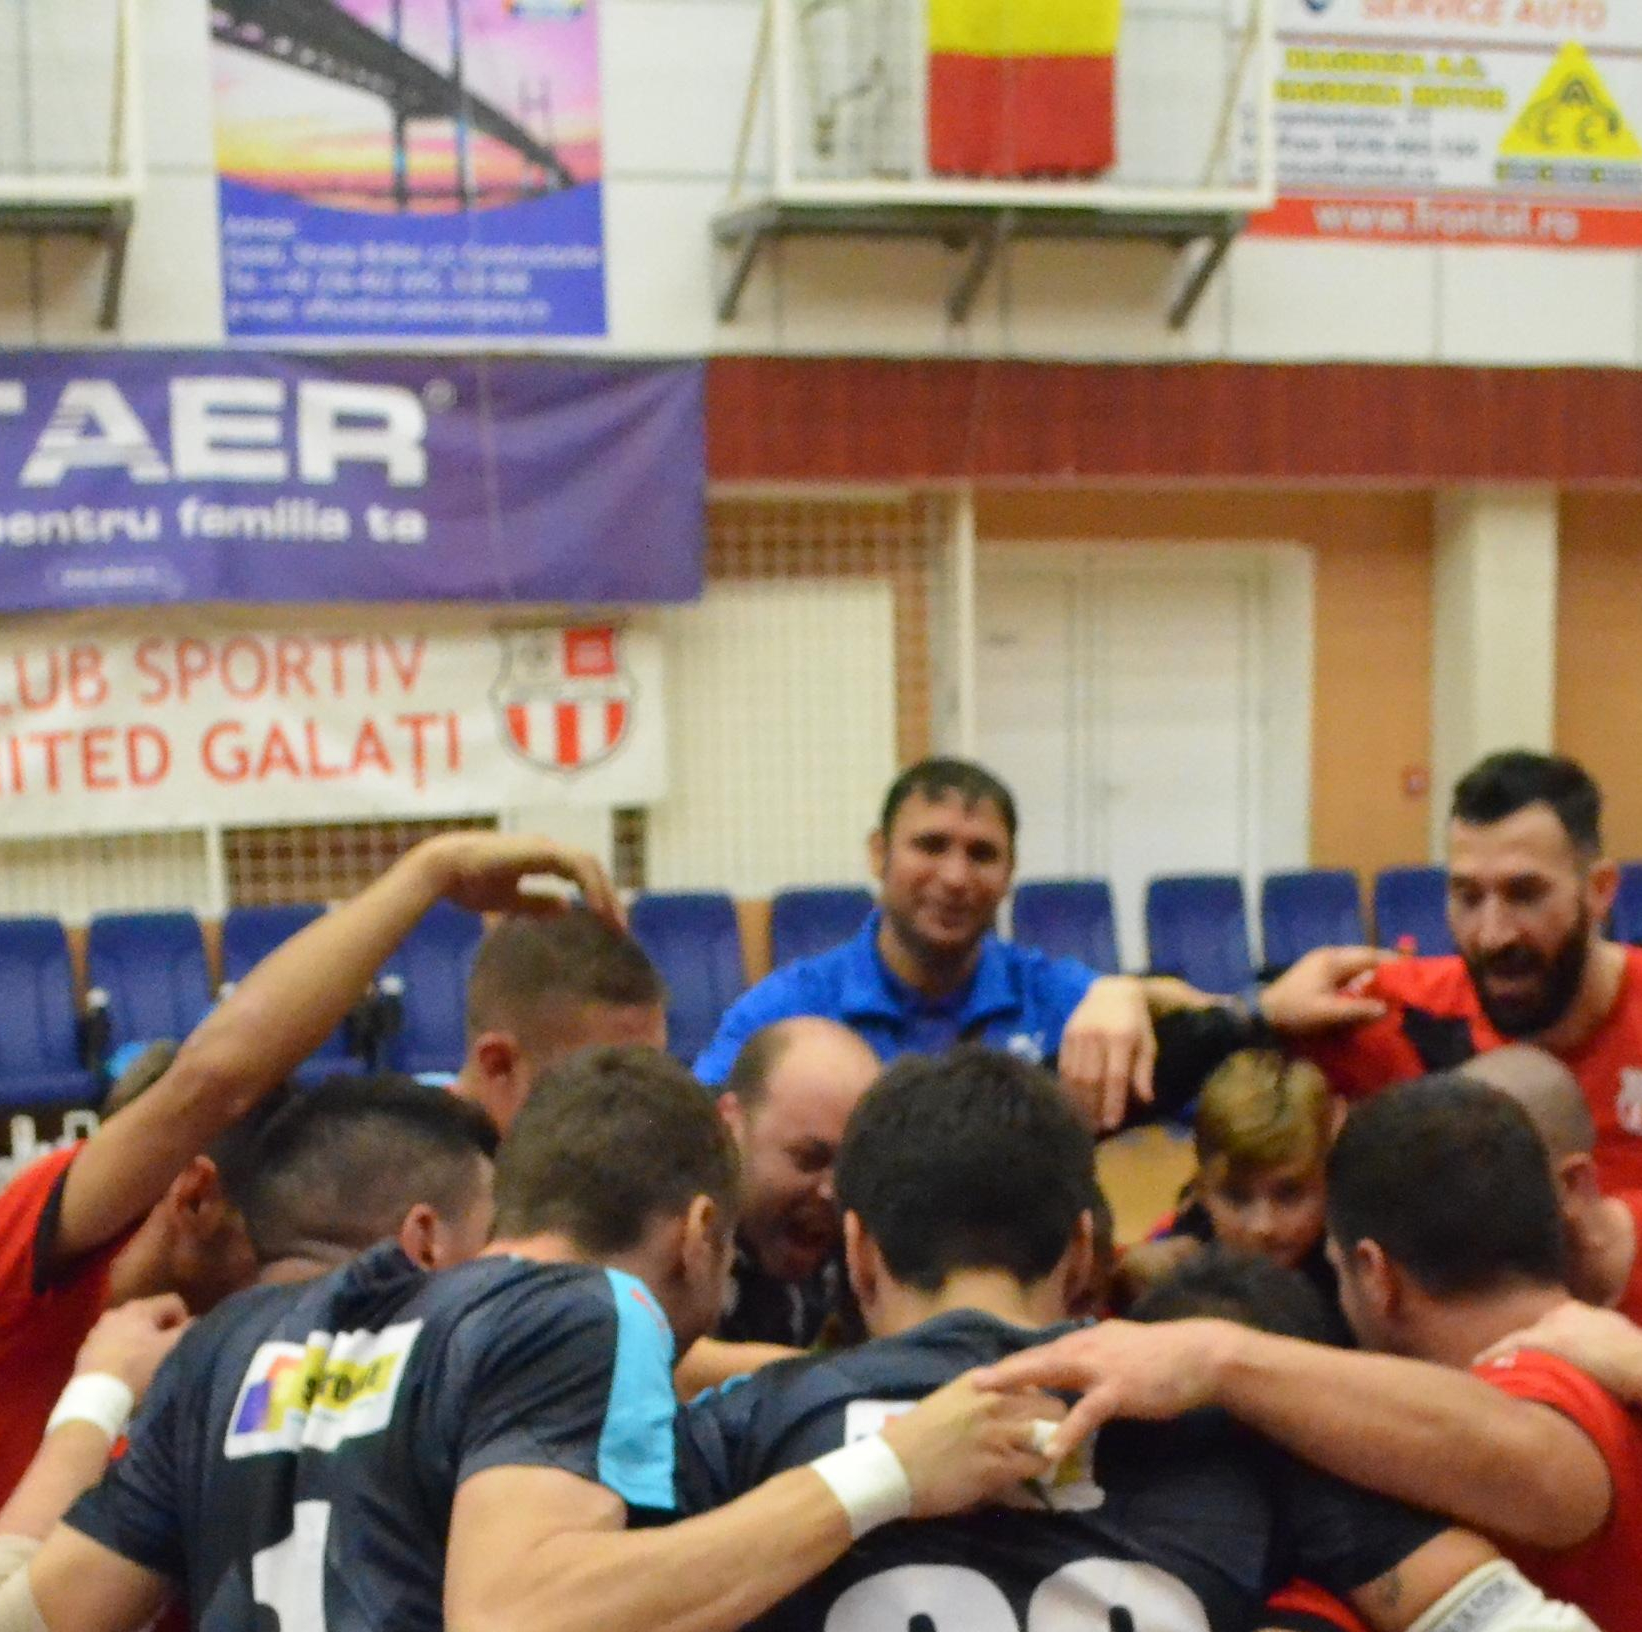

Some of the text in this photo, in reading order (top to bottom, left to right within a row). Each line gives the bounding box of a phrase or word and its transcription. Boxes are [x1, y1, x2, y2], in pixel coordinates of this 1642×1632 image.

[177, 496, 348, 542] familia
[365, 503, 426, 542] ta
[135, 634, 426, 705] SPORTIV
